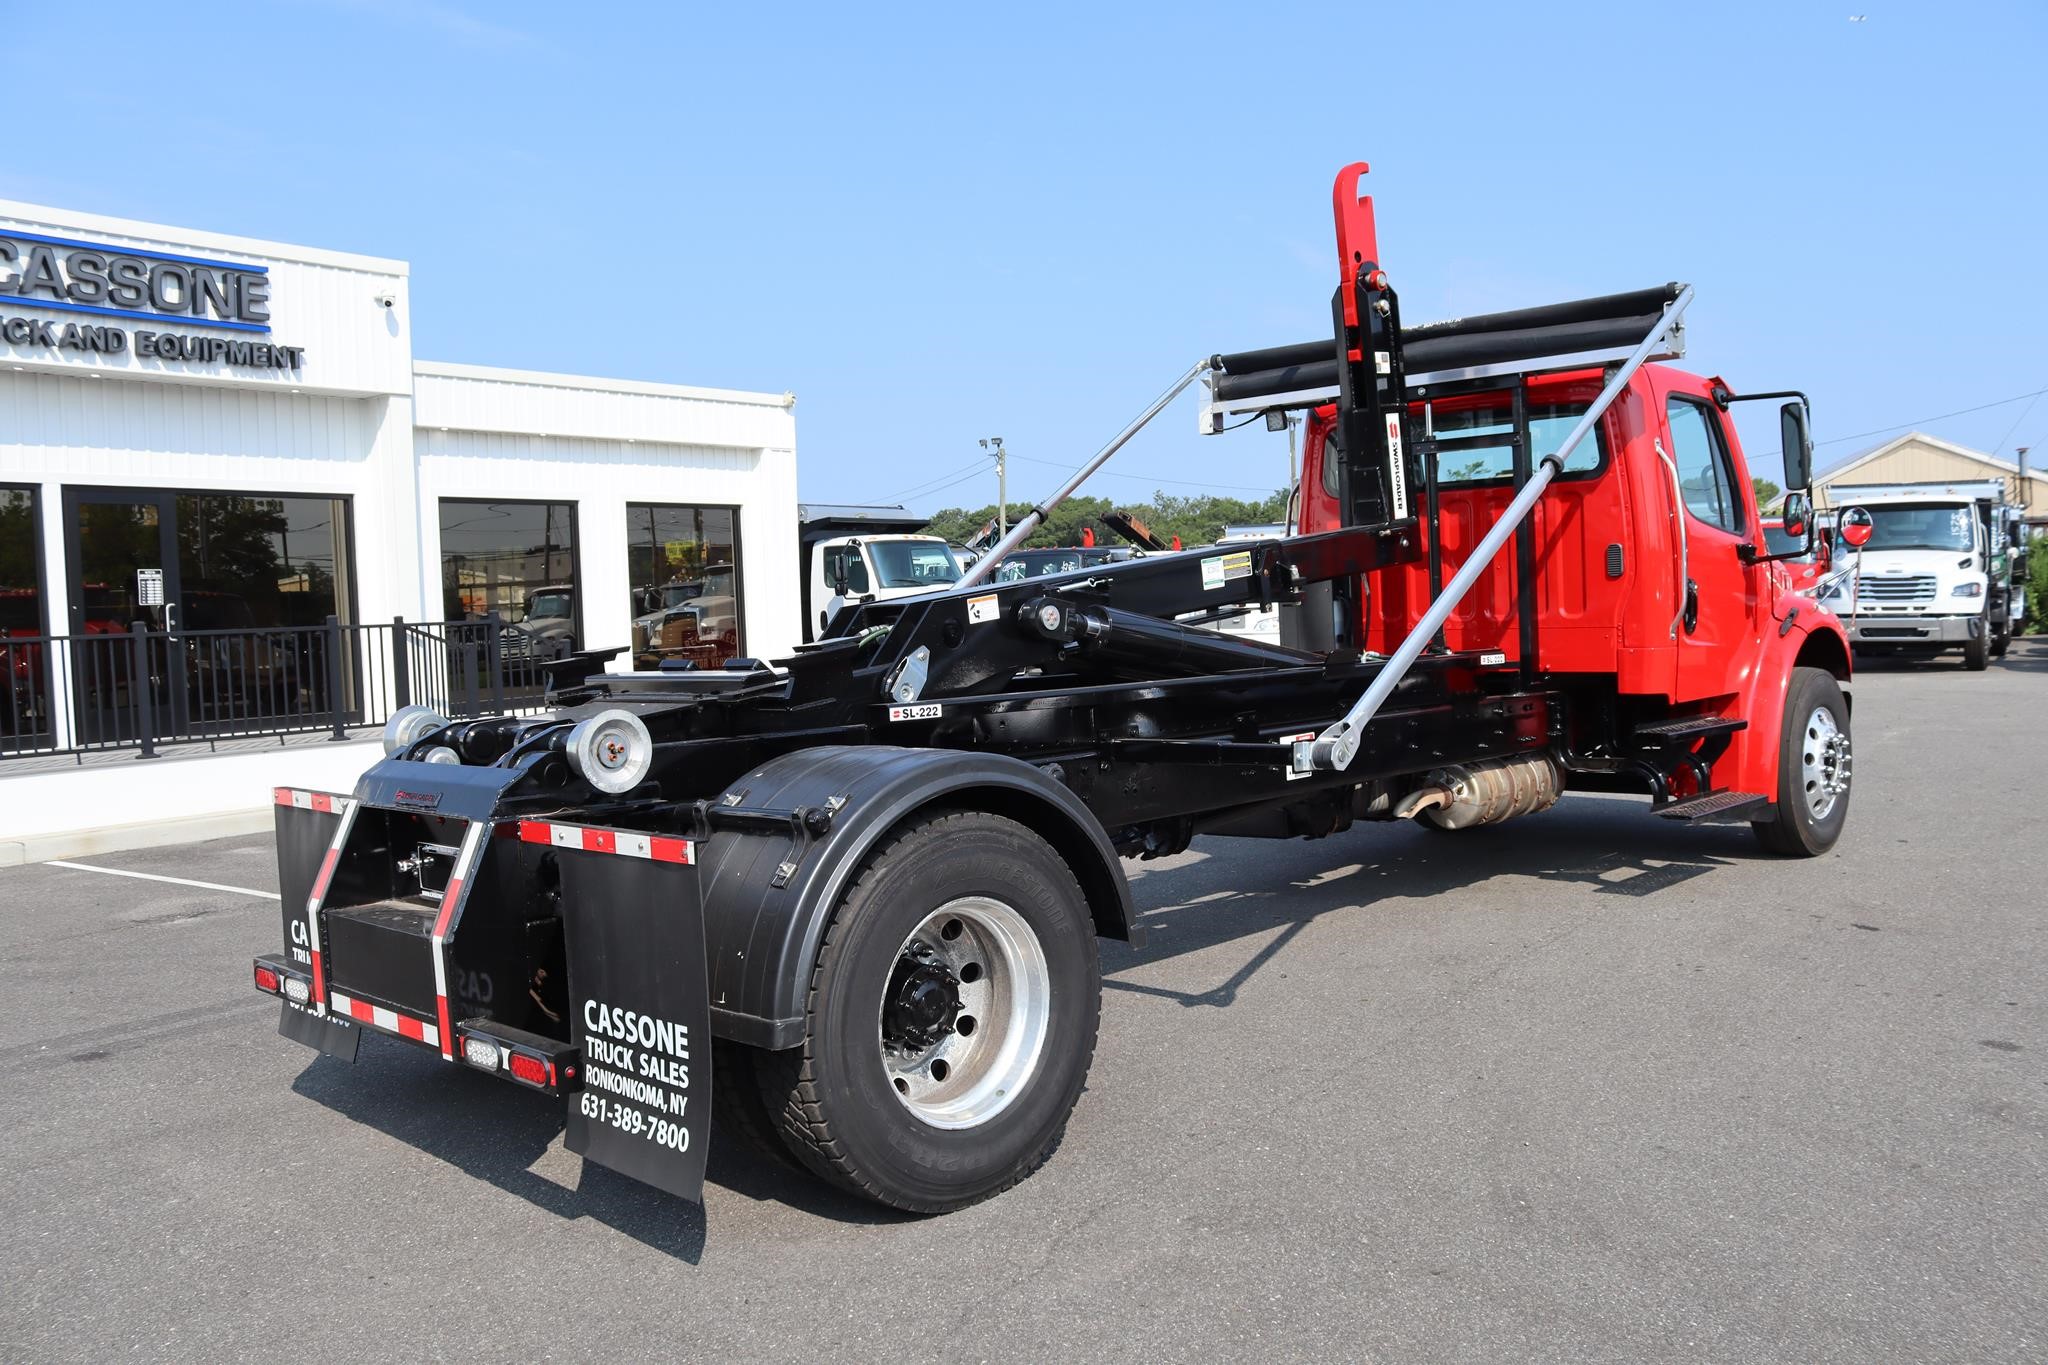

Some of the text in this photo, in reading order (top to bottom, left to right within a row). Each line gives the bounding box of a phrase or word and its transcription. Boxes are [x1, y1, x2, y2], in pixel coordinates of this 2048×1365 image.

[0, 316, 304, 369] CK AND EQUIPMENT
[1392, 442, 1403, 510] SWAPLOADER
[902, 706, 938, 719] SL-222
[291, 920, 309, 946] CA
[584, 1000, 689, 1059] CASSONE
[585, 1035, 689, 1088] TRUCK SALES
[586, 1064, 688, 1116] RONKONKOMA, NY
[581, 1093, 689, 1153] 631-389-7800
